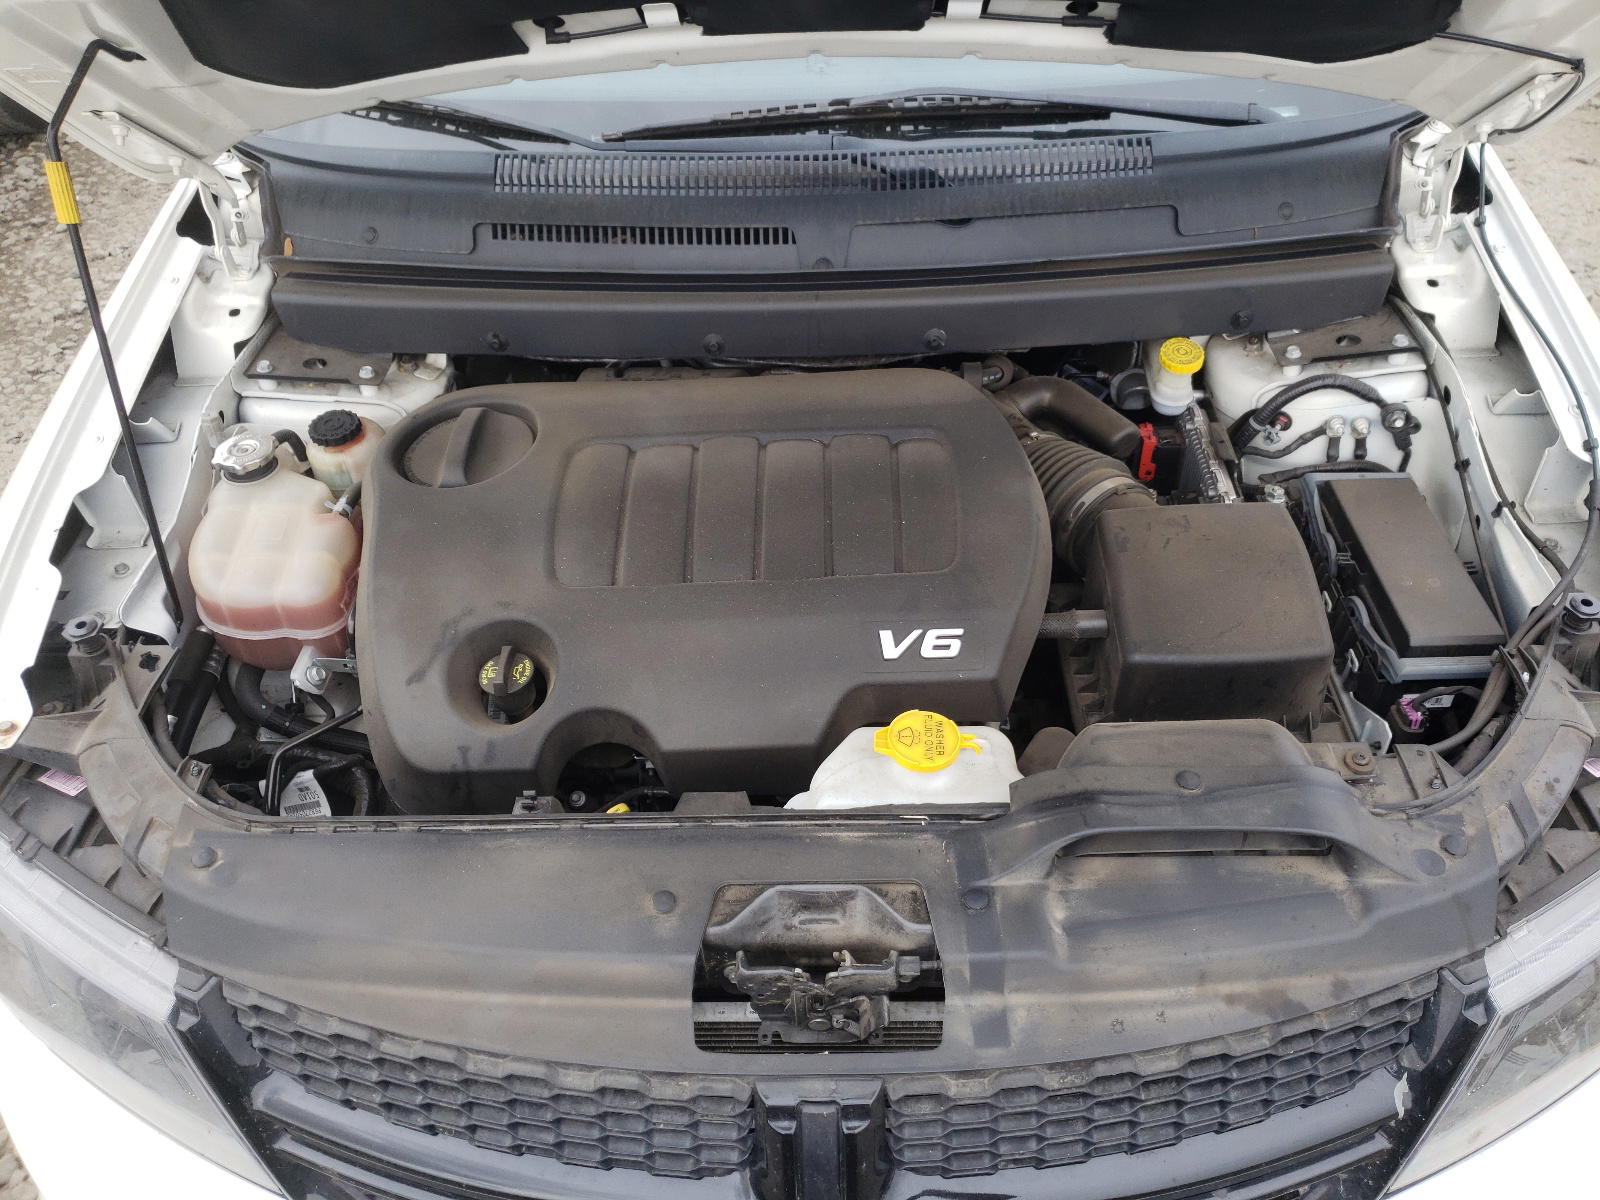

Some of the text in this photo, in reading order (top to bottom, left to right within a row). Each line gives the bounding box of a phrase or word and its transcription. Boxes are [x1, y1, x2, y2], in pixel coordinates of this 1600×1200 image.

[879, 628, 964, 660] V6
[924, 714, 934, 761] FLUID ONLY
[935, 720, 945, 756] WASHER
